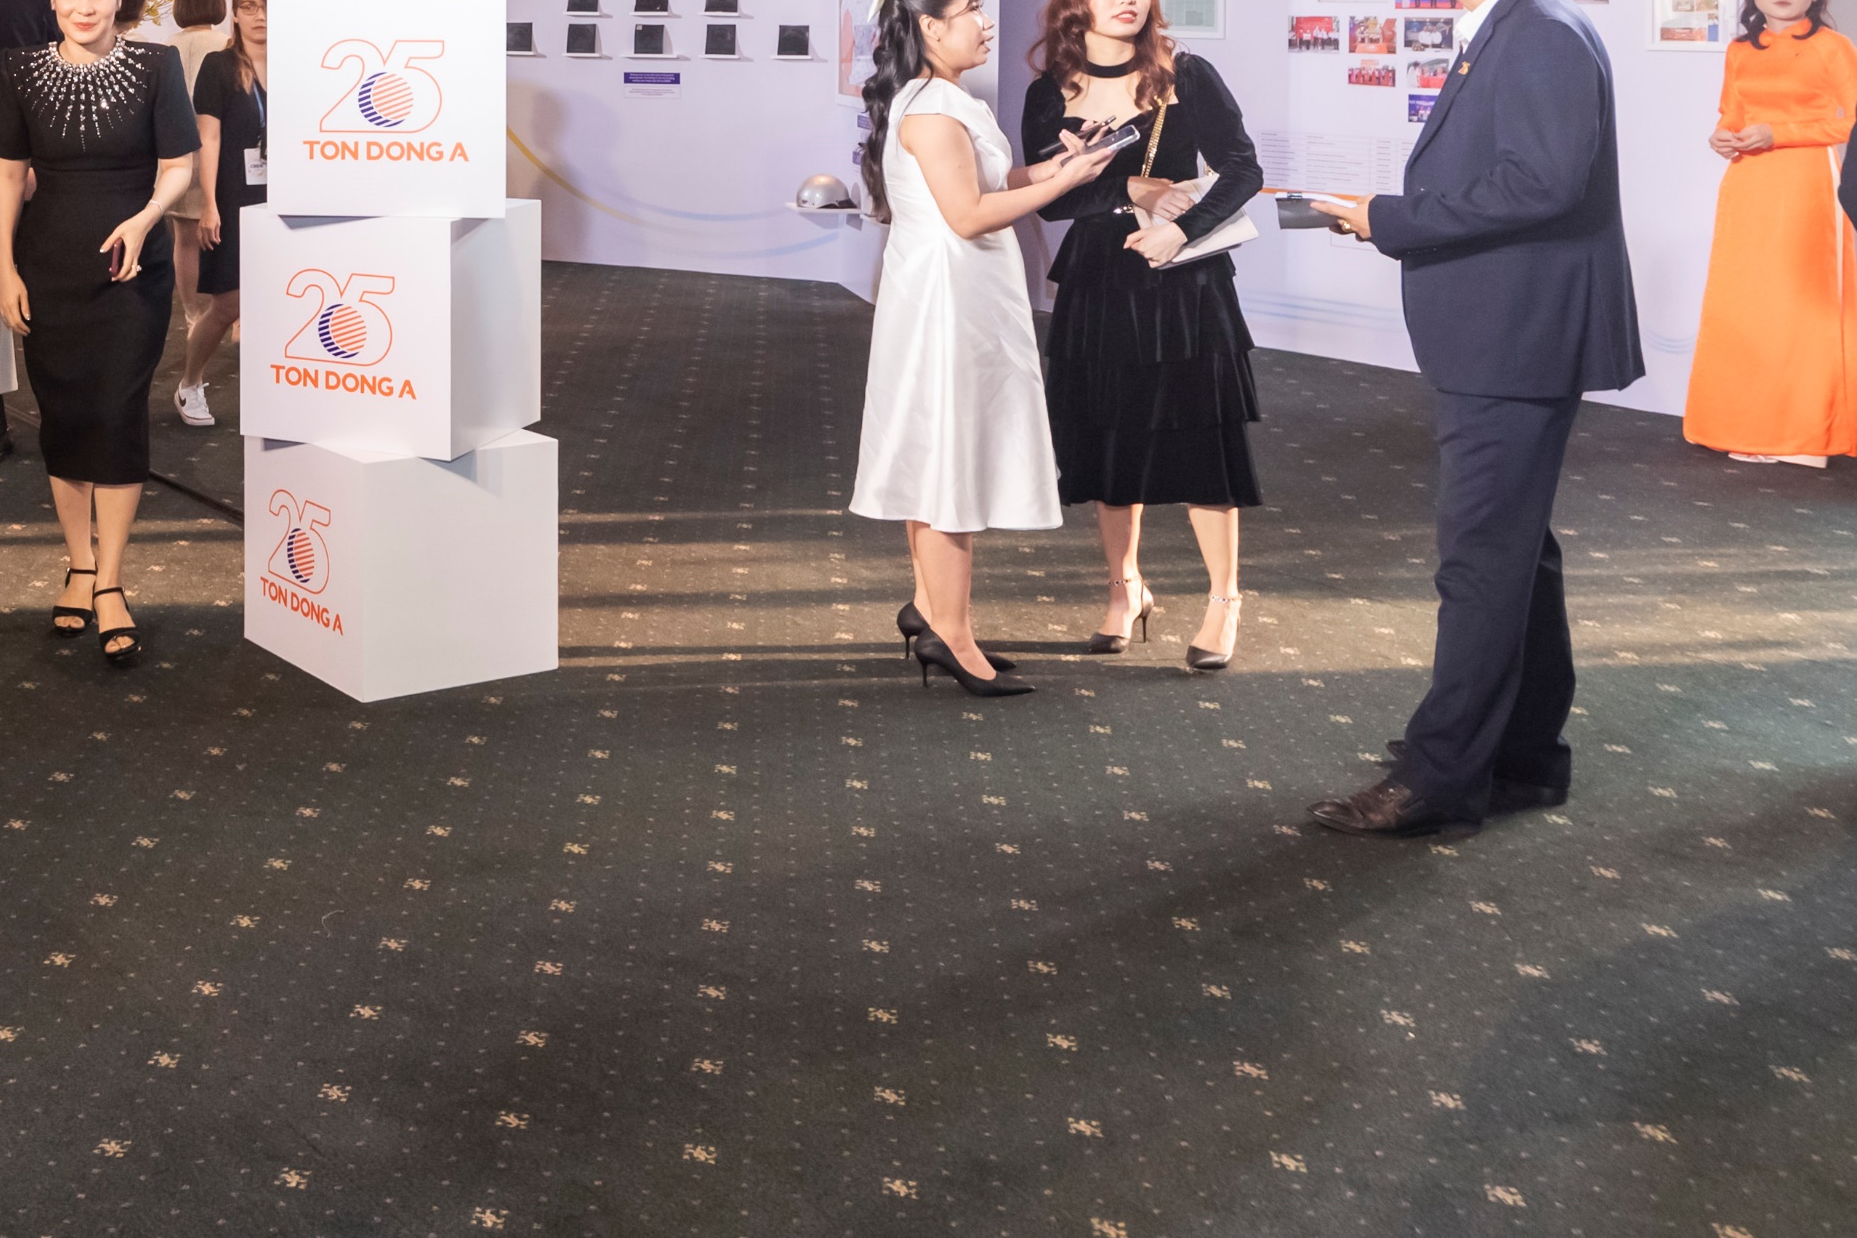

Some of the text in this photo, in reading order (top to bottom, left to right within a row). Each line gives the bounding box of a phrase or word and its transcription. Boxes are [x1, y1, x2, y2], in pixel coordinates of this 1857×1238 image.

[320, 39, 444, 133] 25
[303, 140, 469, 162] TON DONG A
[285, 269, 395, 366] 25
[271, 365, 417, 400] TON DONG A
[268, 489, 331, 594] 25
[261, 576, 343, 636] TON DONG A
